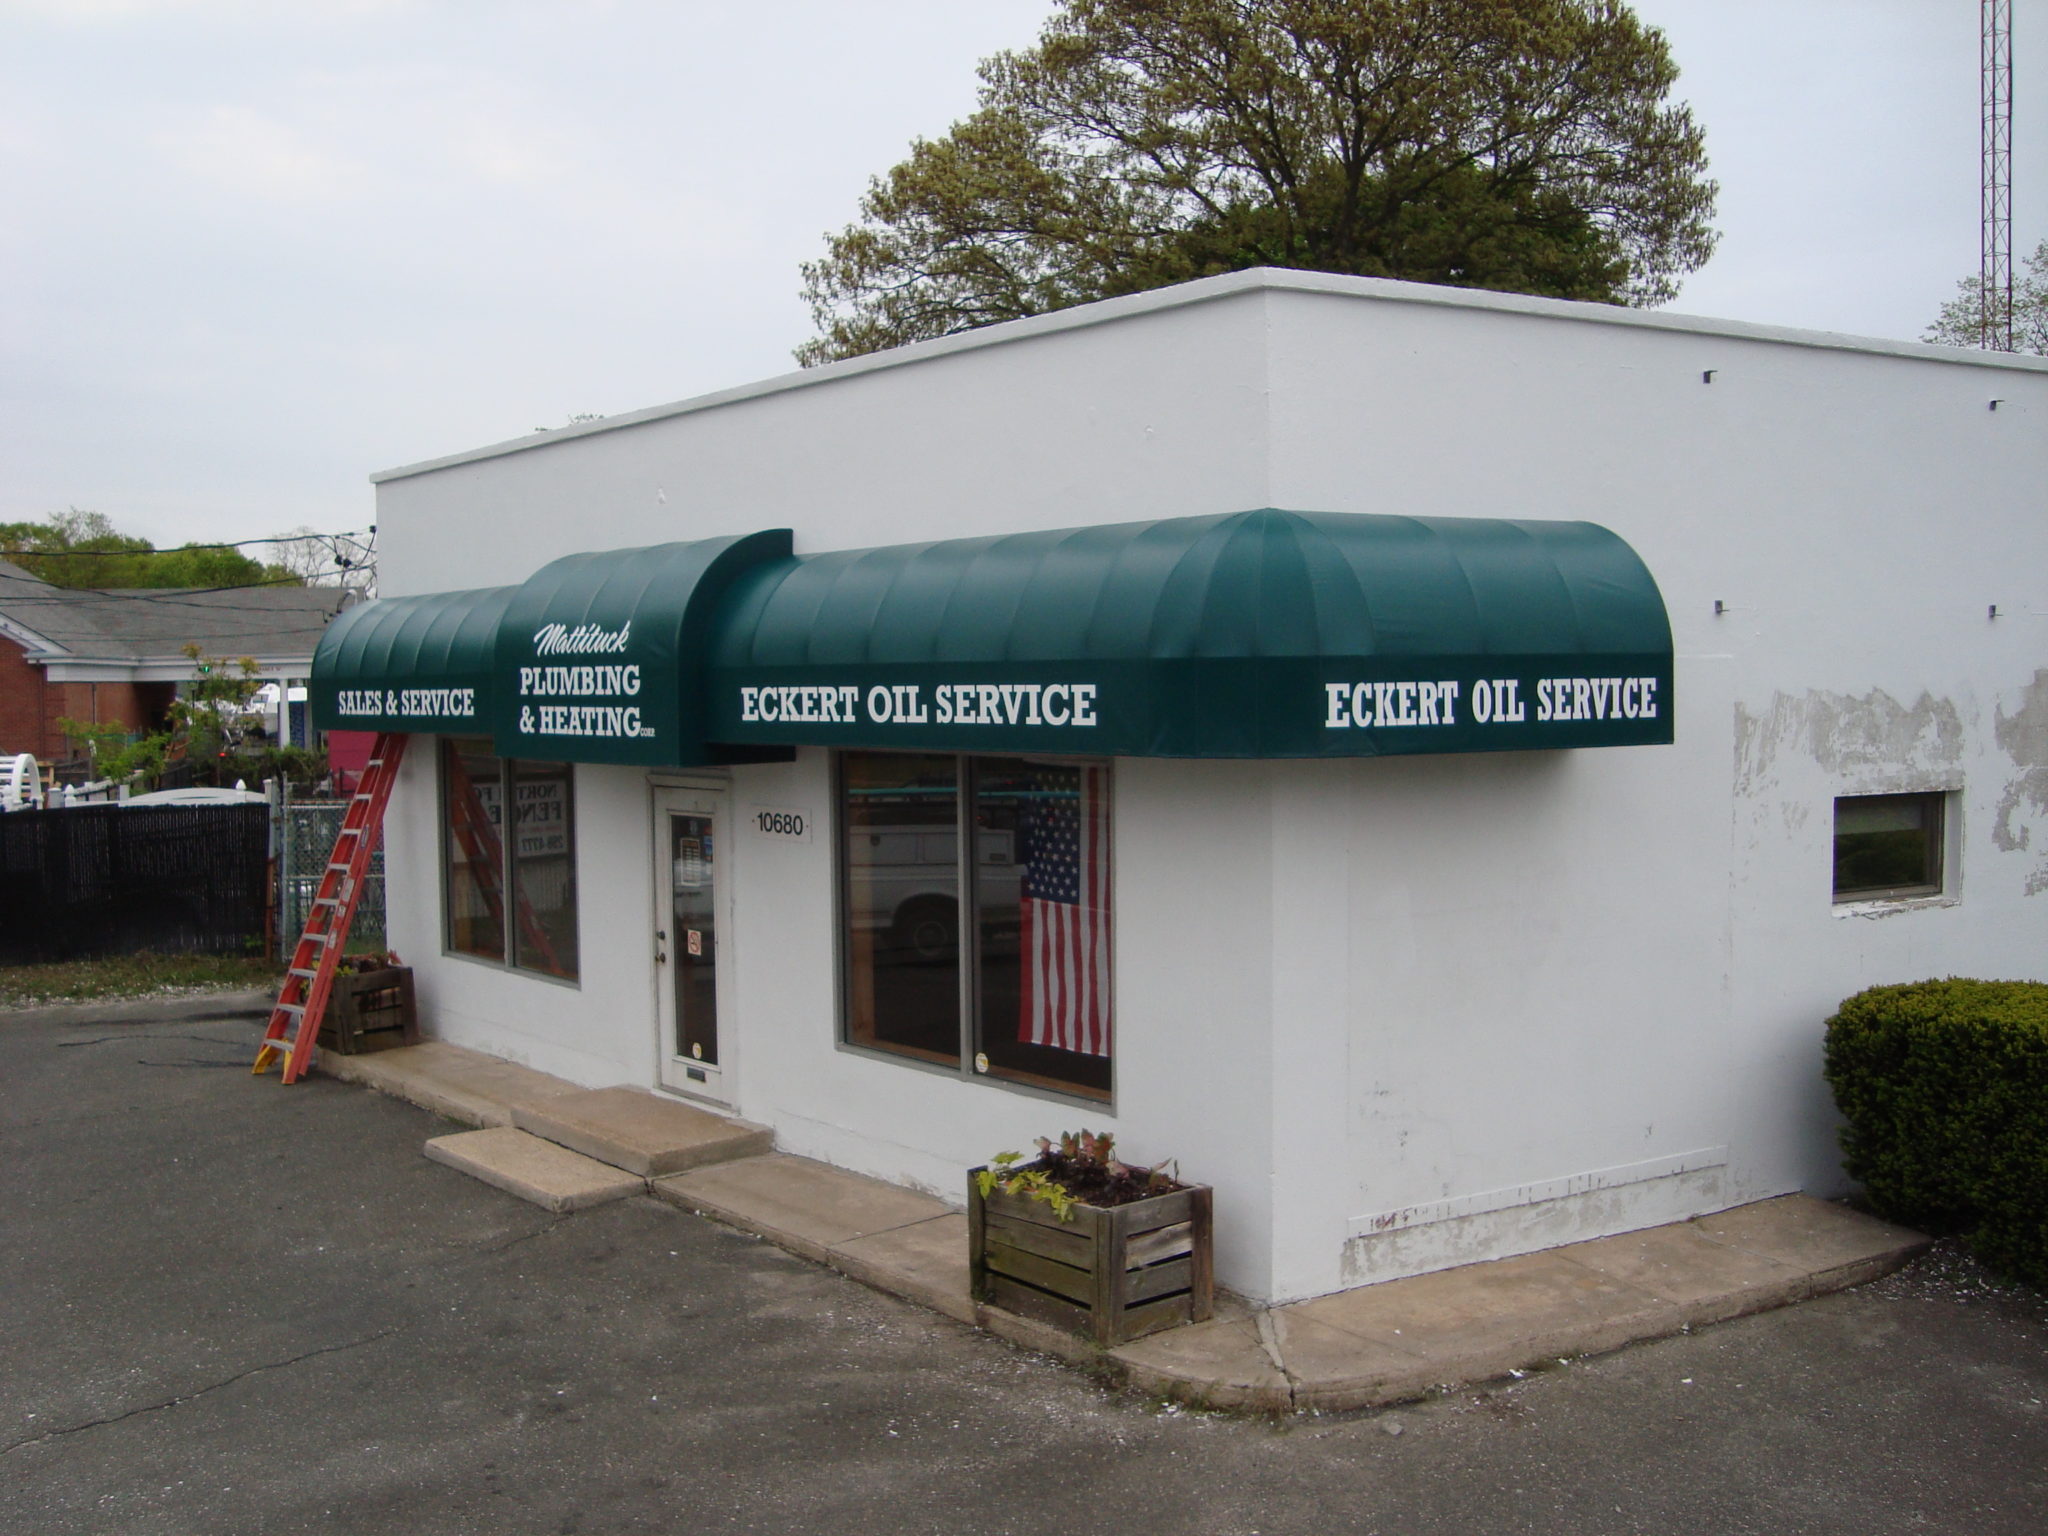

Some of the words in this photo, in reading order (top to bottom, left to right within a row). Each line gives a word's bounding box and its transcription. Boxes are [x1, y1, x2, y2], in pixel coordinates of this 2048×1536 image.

[533, 620, 631, 657] Mattituck
[519, 665, 641, 696] PLUMBING
[338, 690, 382, 716] SALES
[385, 689, 398, 716] &
[401, 688, 475, 717] SERVICE
[741, 686, 858, 723] ECKERT
[867, 685, 927, 724] OIL
[936, 684, 1097, 726] SERVICE
[1325, 680, 1458, 728] ECKERT
[1472, 679, 1525, 724] OIL
[1537, 677, 1657, 721] SERVICE
[519, 705, 535, 734] &
[539, 706, 641, 738] HEATING
[757, 812, 803, 836] 10680
